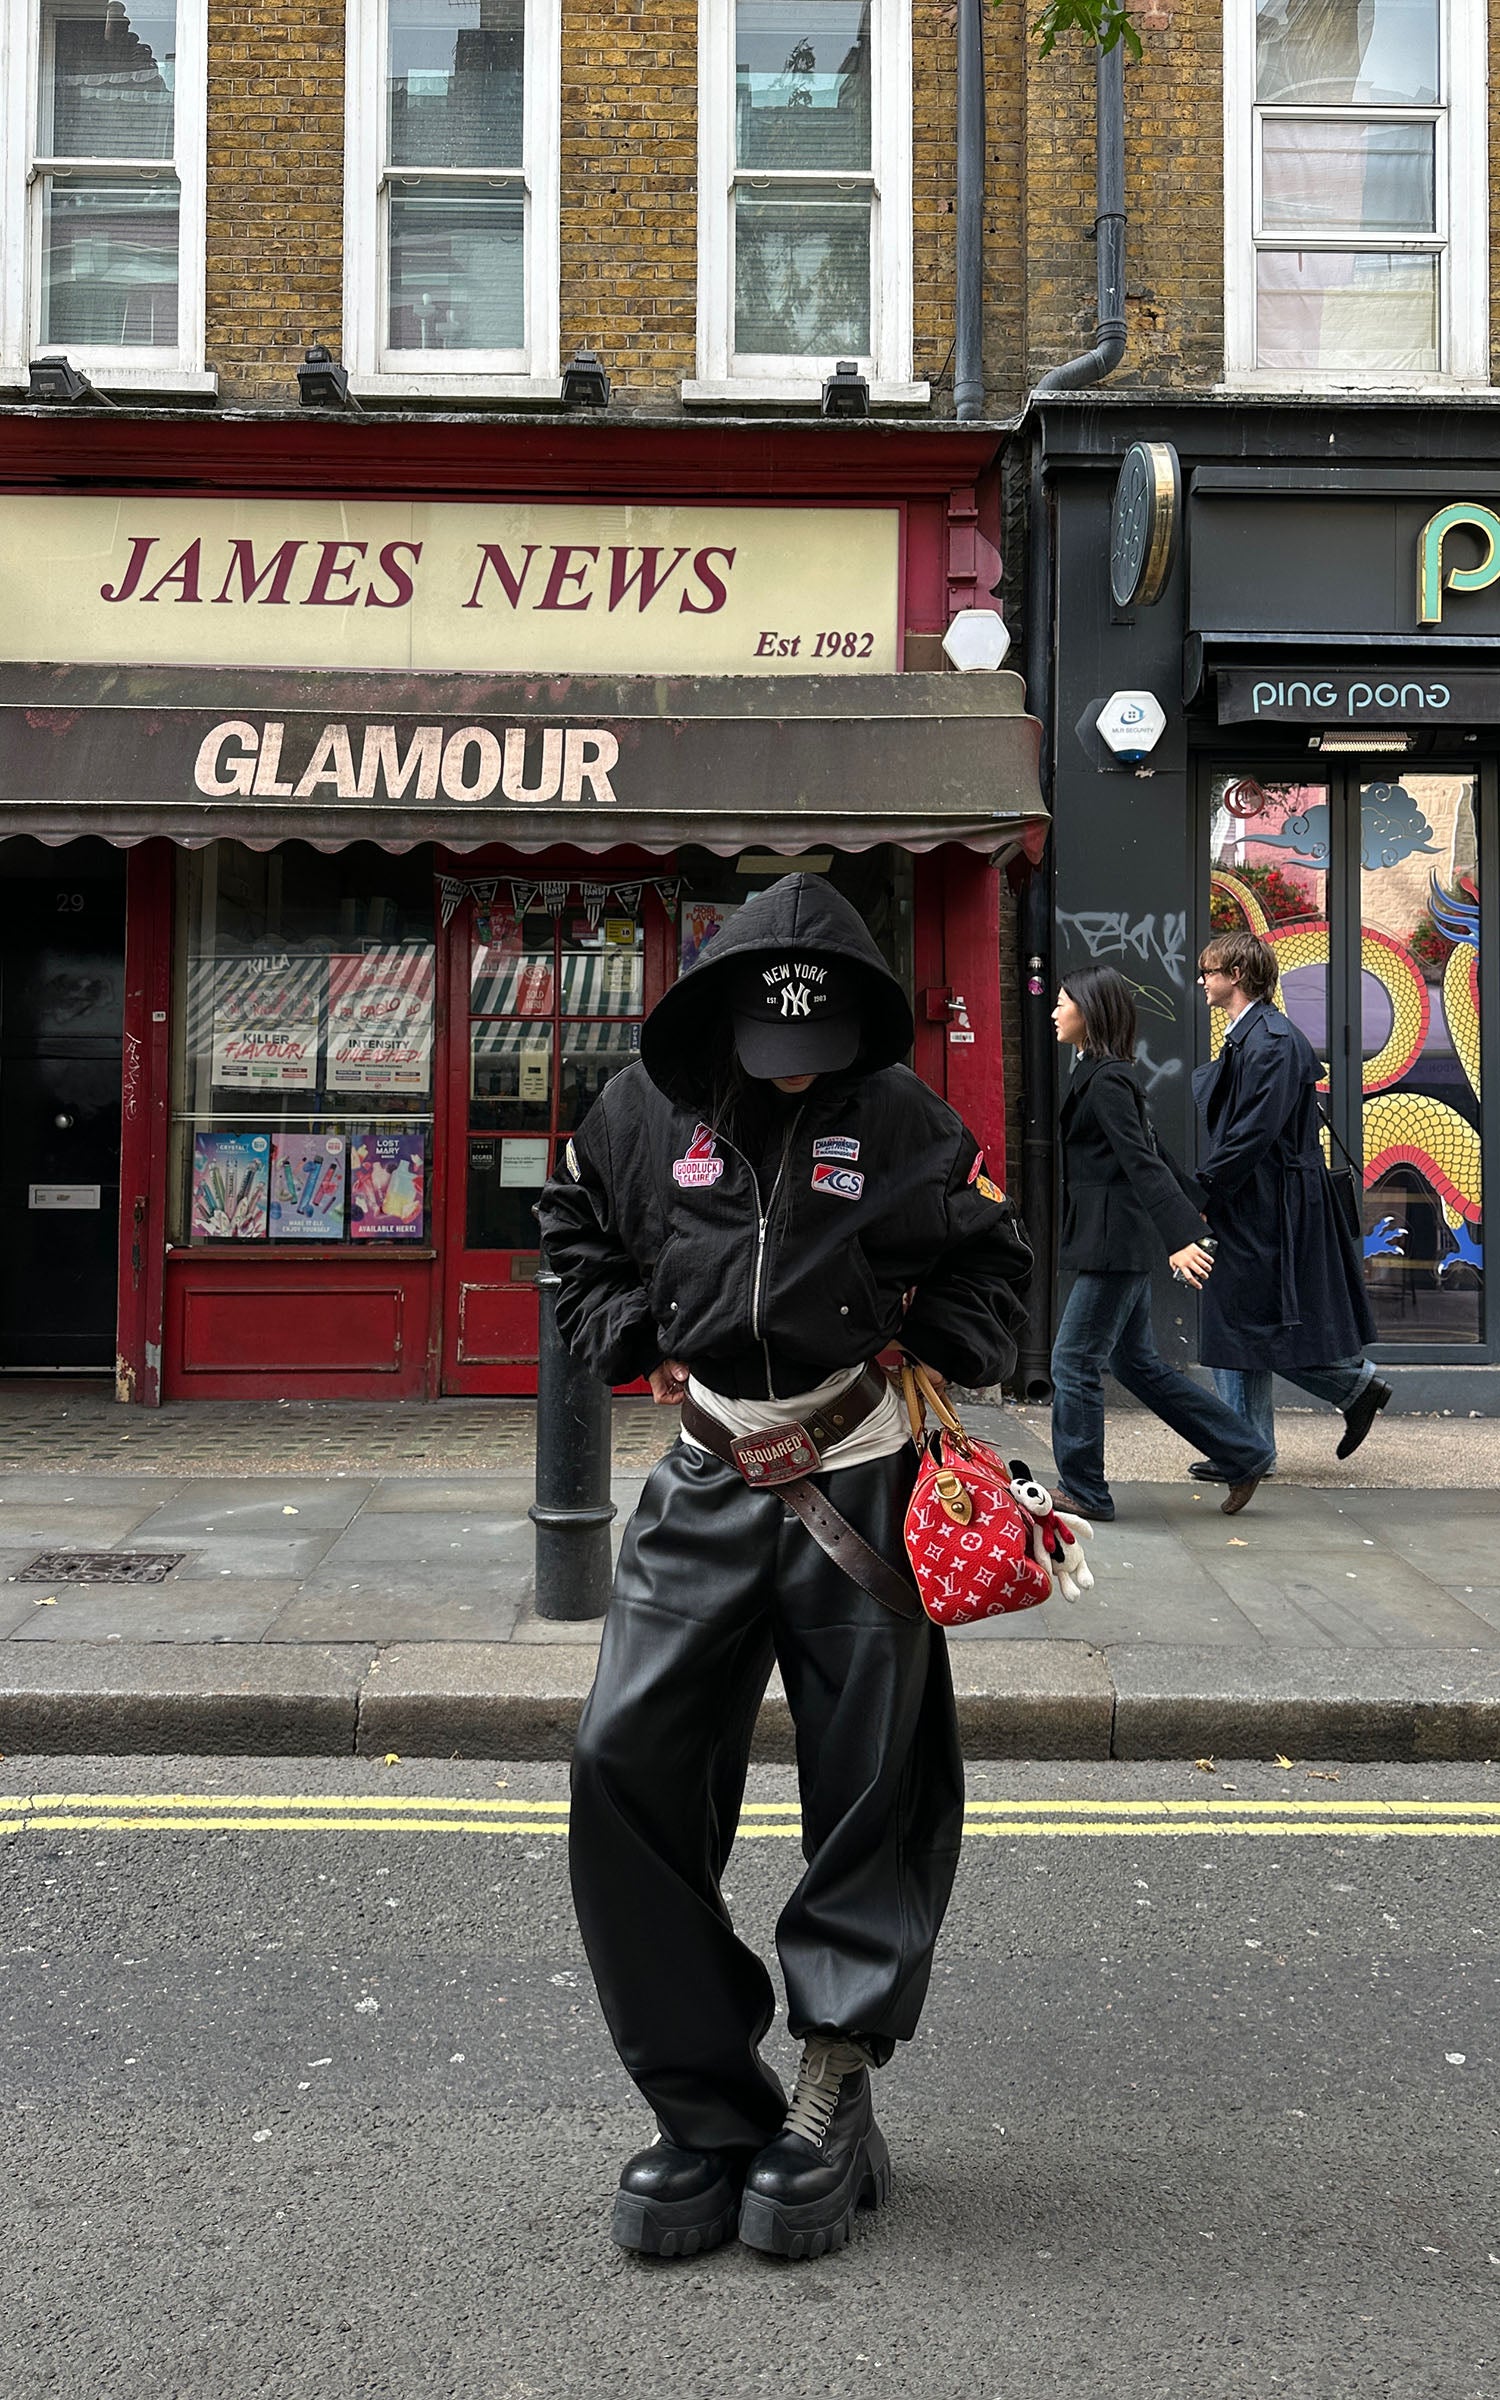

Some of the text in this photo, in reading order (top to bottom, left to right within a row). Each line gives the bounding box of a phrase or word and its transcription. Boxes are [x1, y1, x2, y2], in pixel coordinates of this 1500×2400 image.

[101, 537, 737, 614] JAMES NEWS
[753, 631, 875, 658] Est 1982
[194, 720, 620, 802] GLAMOUR
[57, 894, 84, 912] 29
[247, 954, 291, 976] KILLA
[361, 960, 404, 977] PABLO
[762, 963, 828, 987] NEW YORK
[526, 990, 545, 1000] SOLD
[780, 981, 812, 1017] NY
[243, 1033, 290, 1045] KILLER
[348, 1039, 410, 1050] INTENSITY
[224, 1041, 308, 1061] FLAVOUR!
[335, 1048, 423, 1064] UNLEASHED!
[375, 1147, 401, 1155] MARY
[376, 1139, 400, 1147] LOST
[677, 1162, 718, 1175] GOODLUCK
[683, 1173, 710, 1182] CLAIRE
[358, 1225, 417, 1233] AVAILABLE HERE!
[981, 1489, 1010, 1511] LV
[912, 1504, 936, 1530] LV
[1007, 1557, 1032, 1582] LV
[934, 1572, 962, 1597] LV
